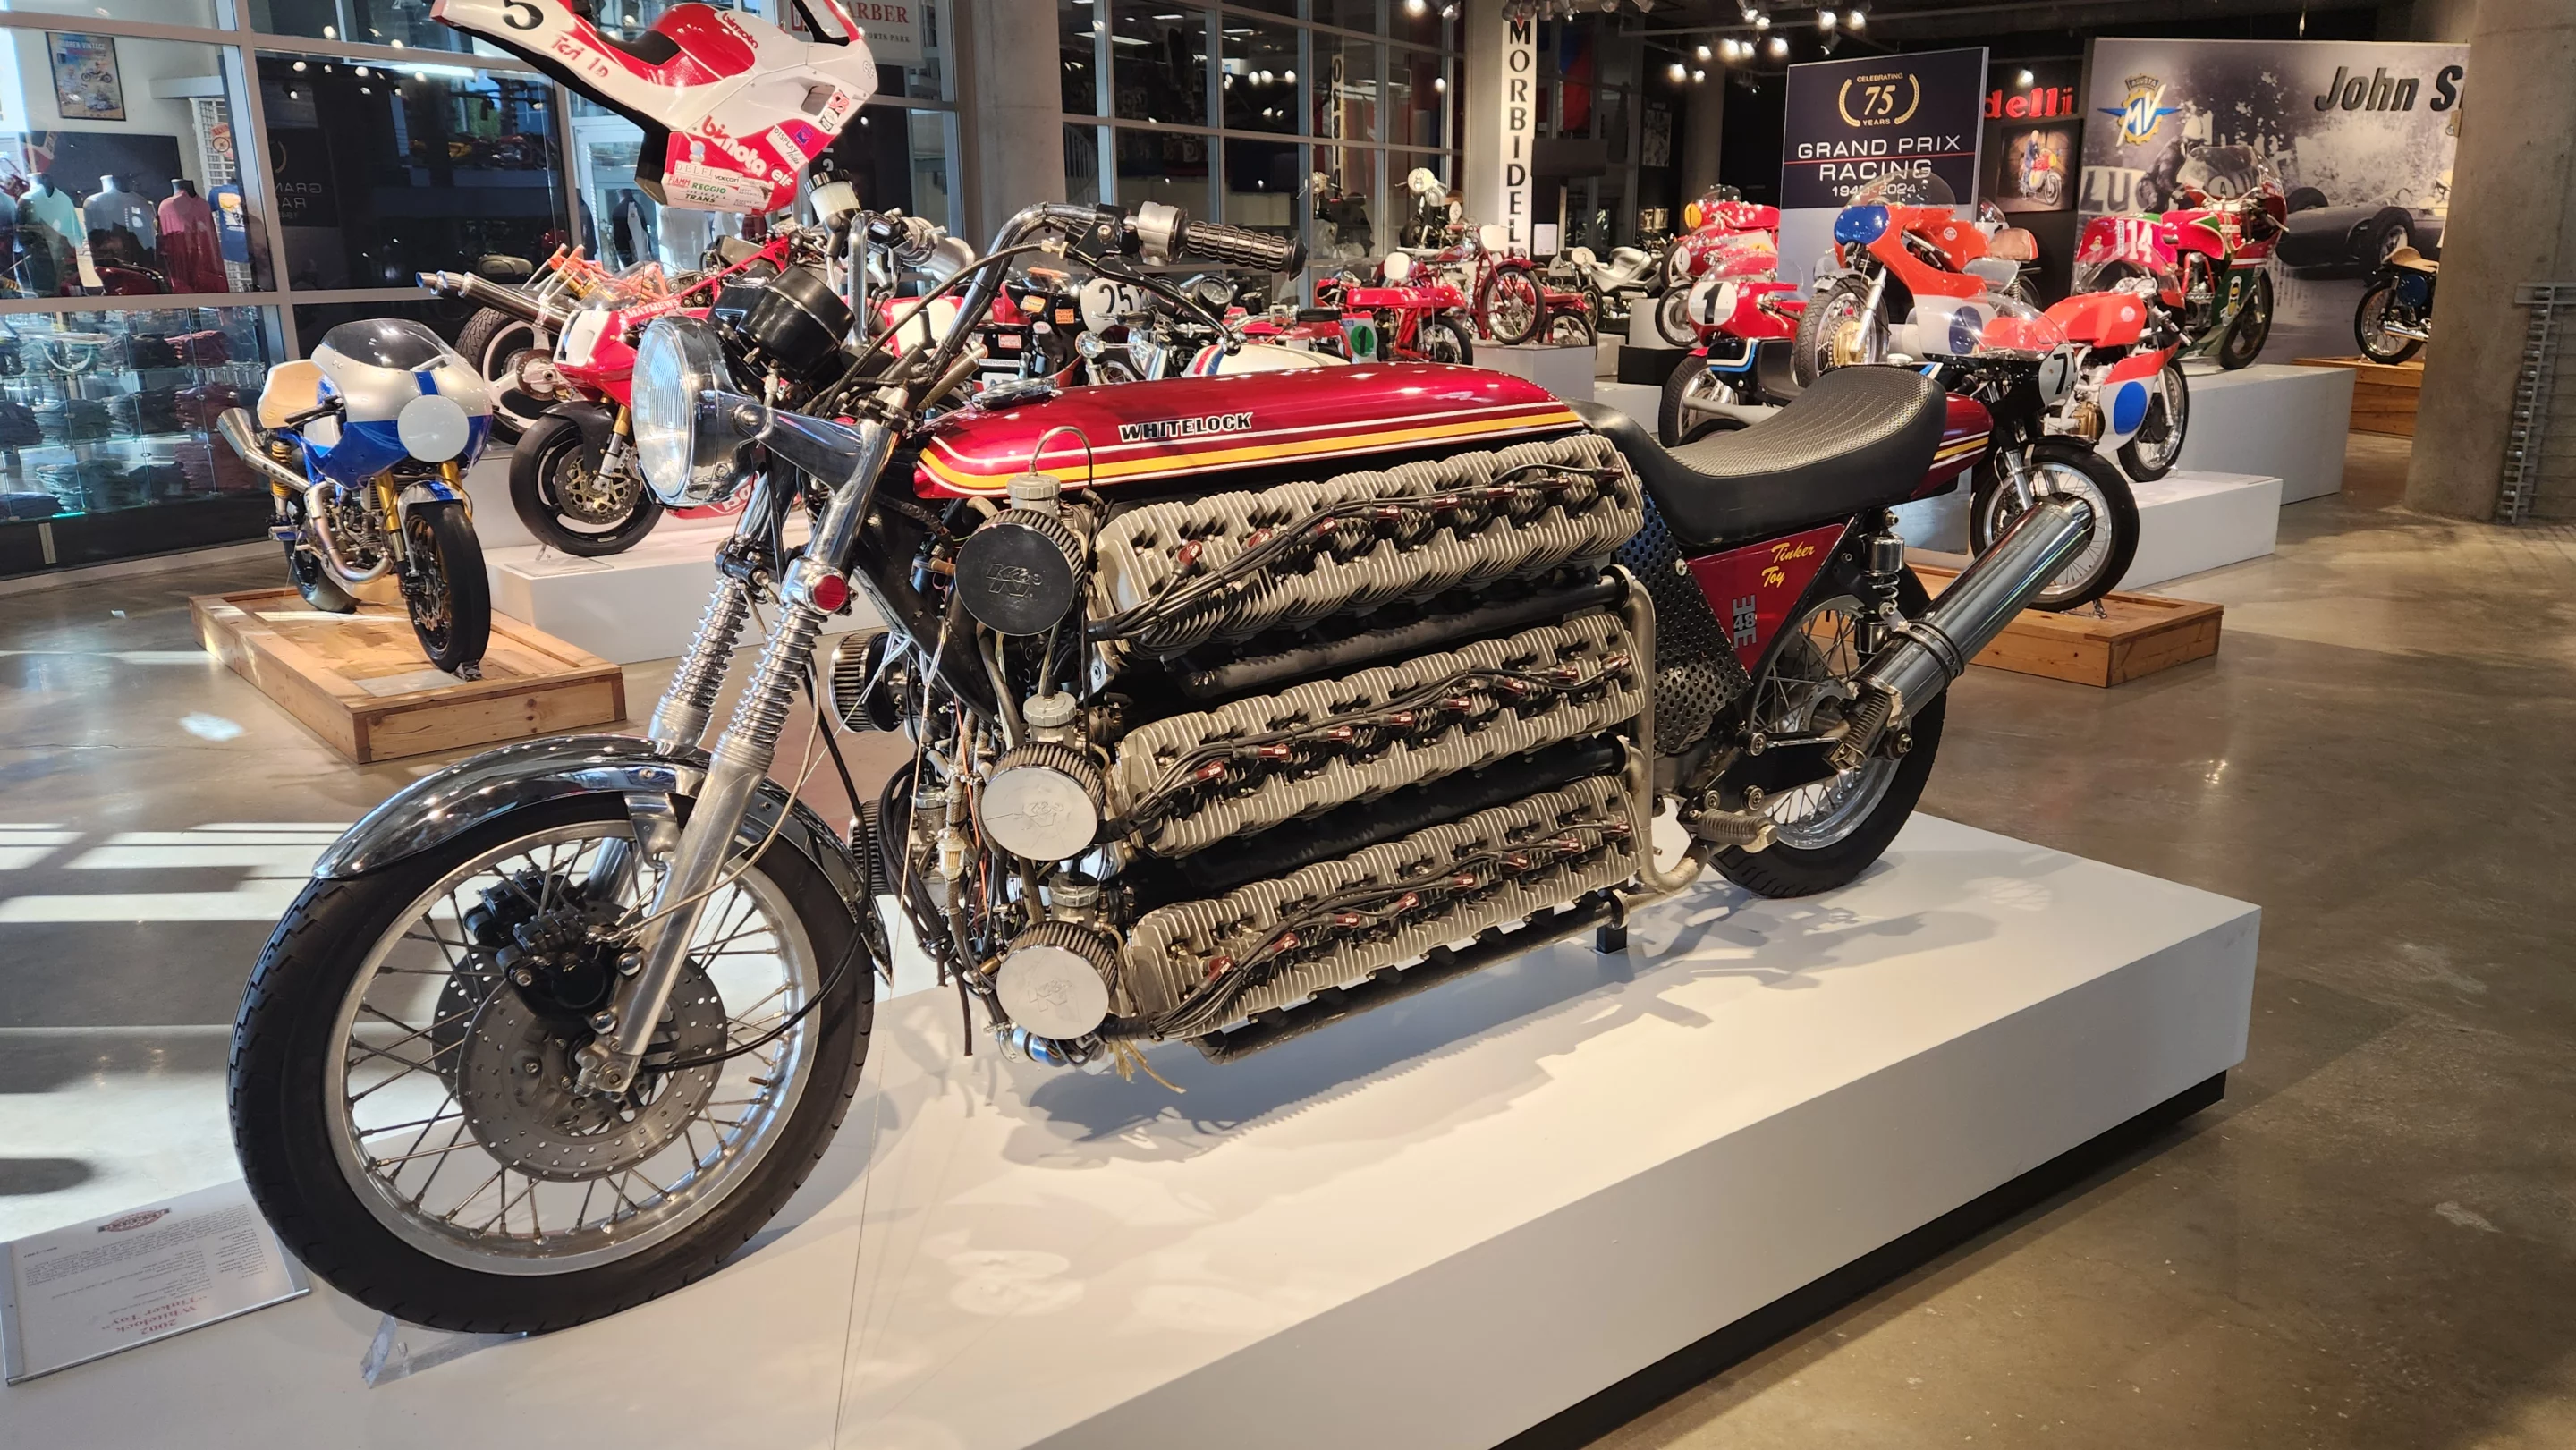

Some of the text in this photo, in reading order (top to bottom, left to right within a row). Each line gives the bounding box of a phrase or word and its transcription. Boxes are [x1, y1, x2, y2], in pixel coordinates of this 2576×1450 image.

[503, 0, 544, 30] 5
[845, 2, 910, 24] ARBER
[890, 34, 911, 43] PARK
[1856, 72, 1903, 82] CELEBRATING
[2314, 65, 2464, 111] John S
[1864, 85, 1896, 115] 75
[1862, 118, 1891, 126] YEARS
[2116, 83, 2166, 147] MV
[701, 114, 767, 177] bimota
[774, 127, 798, 153] DISPLAY
[1798, 134, 1961, 159] GRAND PRIX
[675, 162, 713, 177] DELFI
[771, 167, 794, 187] elf
[1819, 159, 1932, 181] RACING
[685, 193, 716, 203] TRANS
[691, 182, 726, 194] REGGIO
[2126, 220, 2153, 263] 14
[1099, 284, 1134, 314] 25
[1702, 283, 1724, 324] 1
[1358, 326, 1367, 355] 1
[1118, 412, 1254, 443] WHITELOCK
[1771, 541, 1816, 564] Tinker
[1761, 566, 1785, 588] Toy
[1733, 613, 1757, 632] 48
